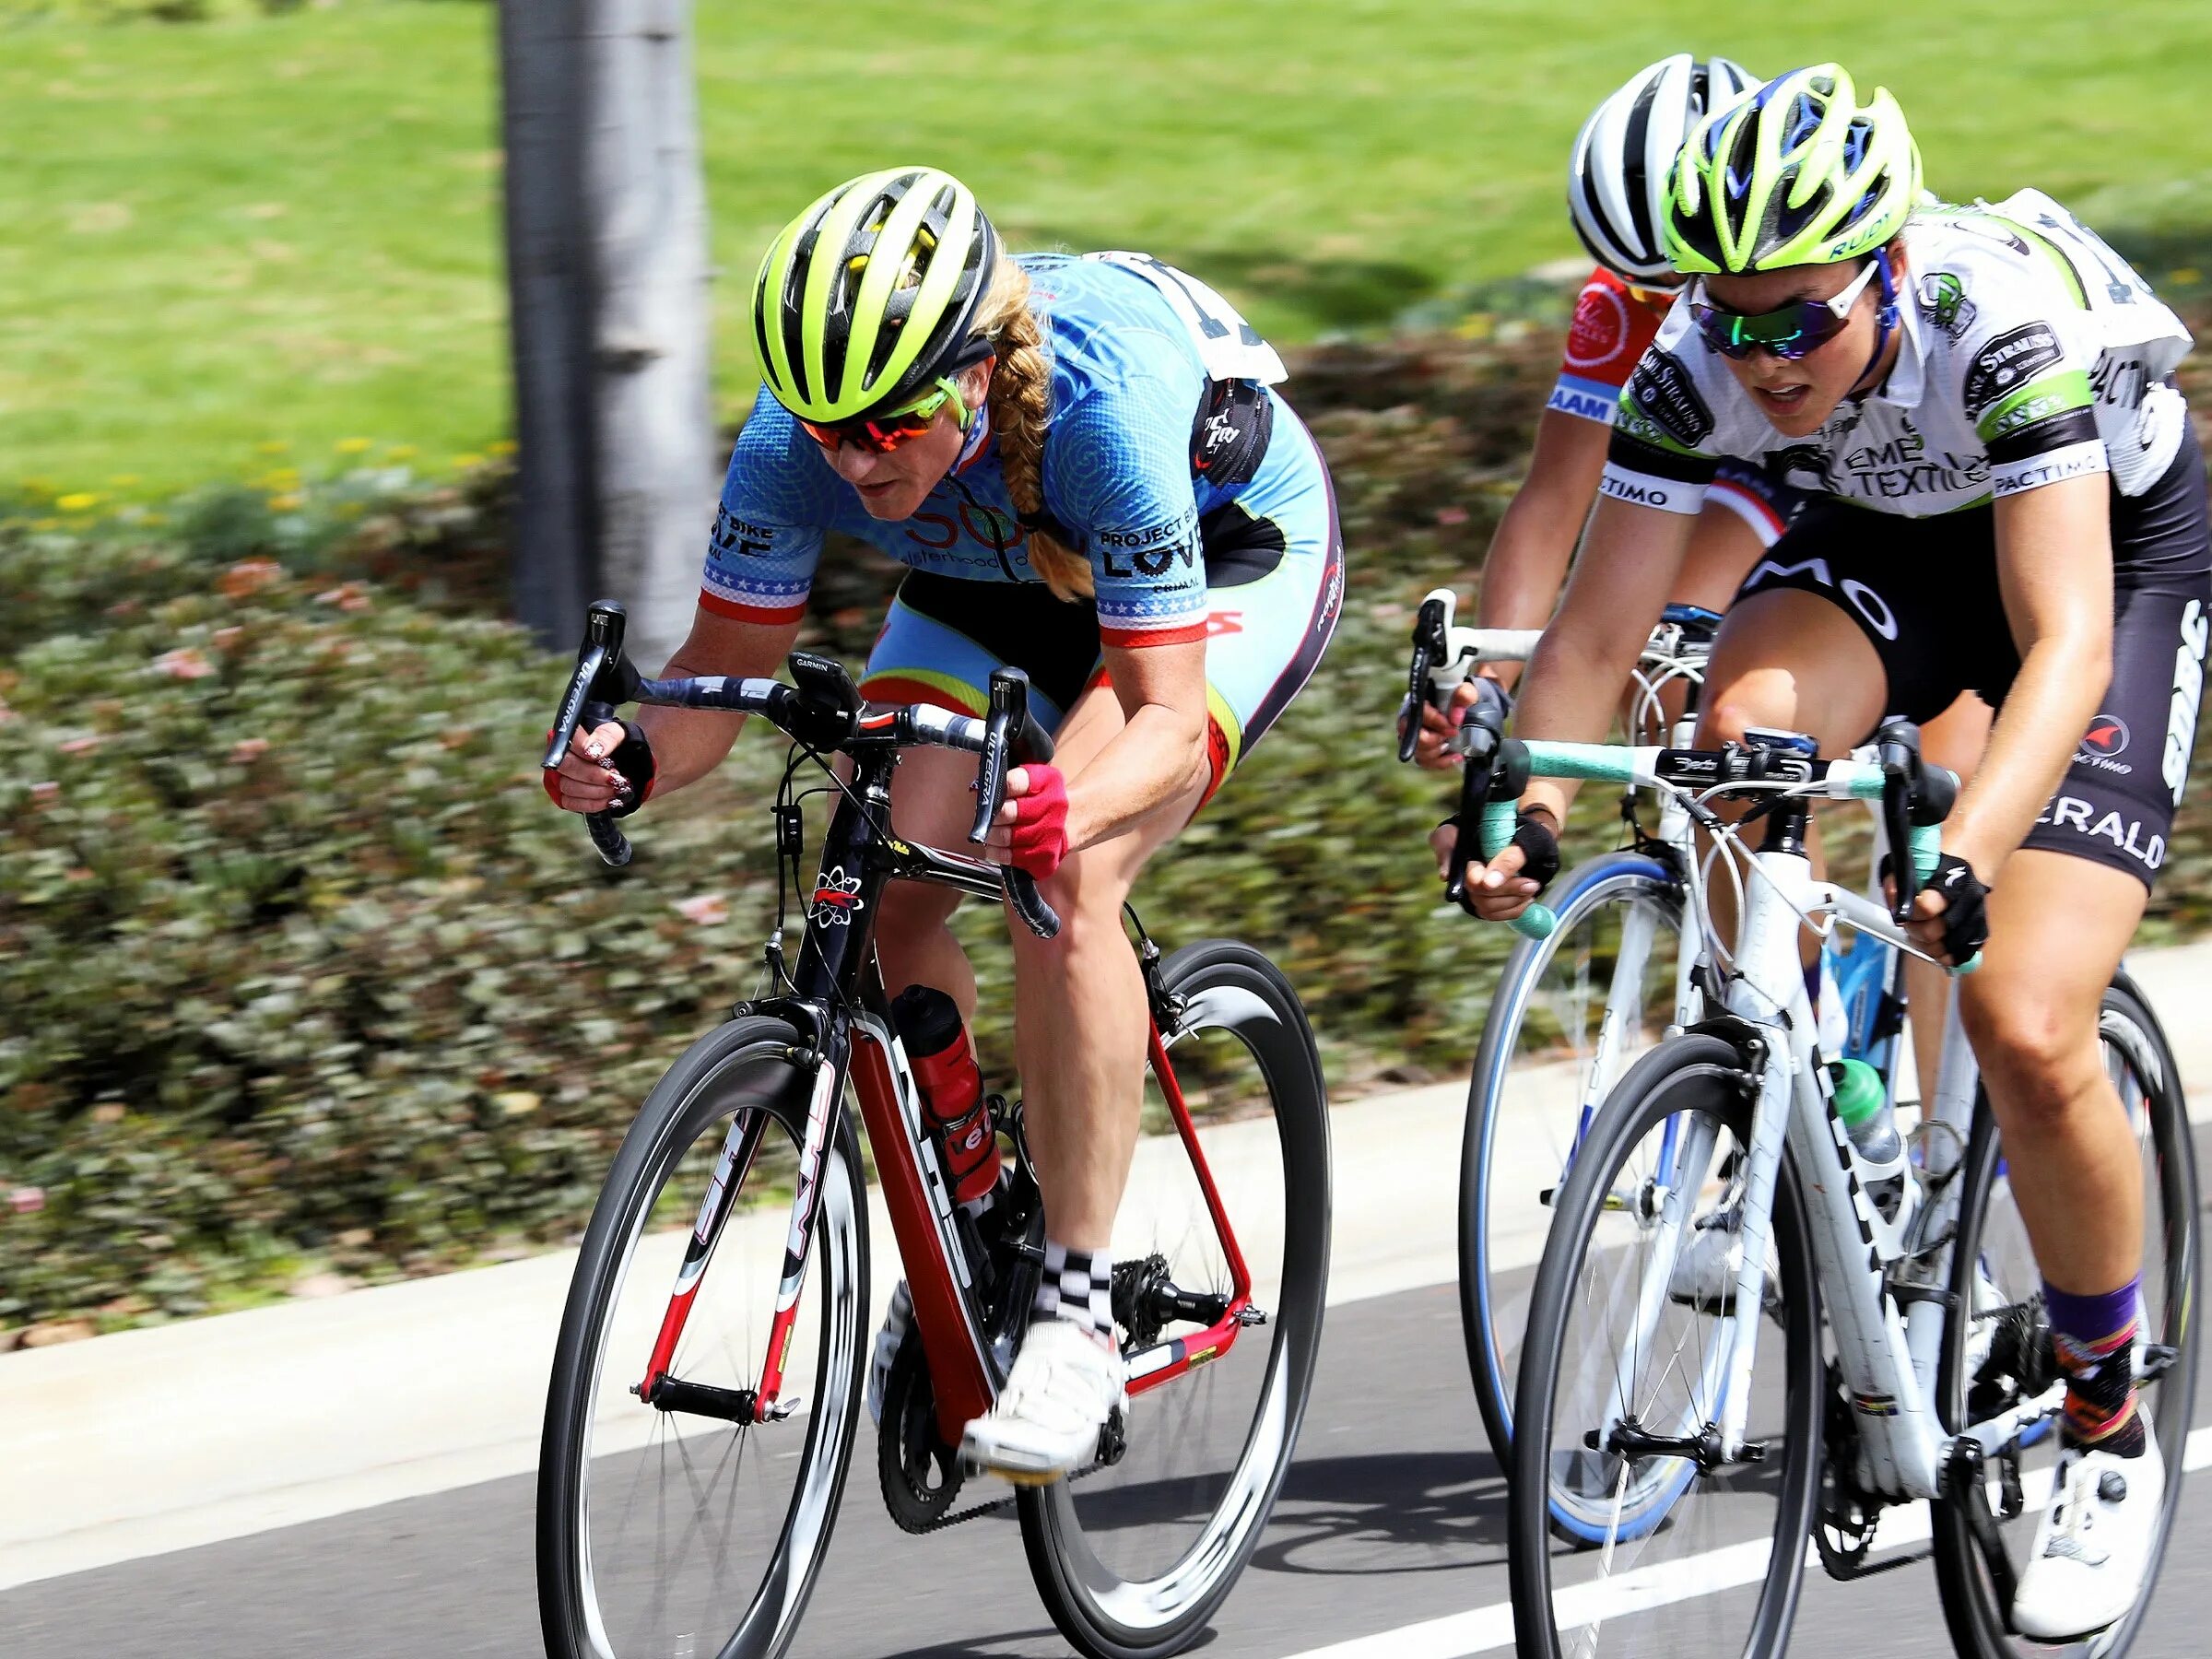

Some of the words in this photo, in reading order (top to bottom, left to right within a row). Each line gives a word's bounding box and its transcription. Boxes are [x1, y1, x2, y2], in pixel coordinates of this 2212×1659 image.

[1829, 213, 1889, 259] RUD
[1600, 476, 1667, 506] TIMO
[729, 515, 773, 539] BIKE
[1100, 518, 1182, 547] PROJECT
[796, 657, 829, 672] GARMIN
[559, 661, 592, 733] ULTEGRA
[981, 731, 998, 806] ULTEGRA
